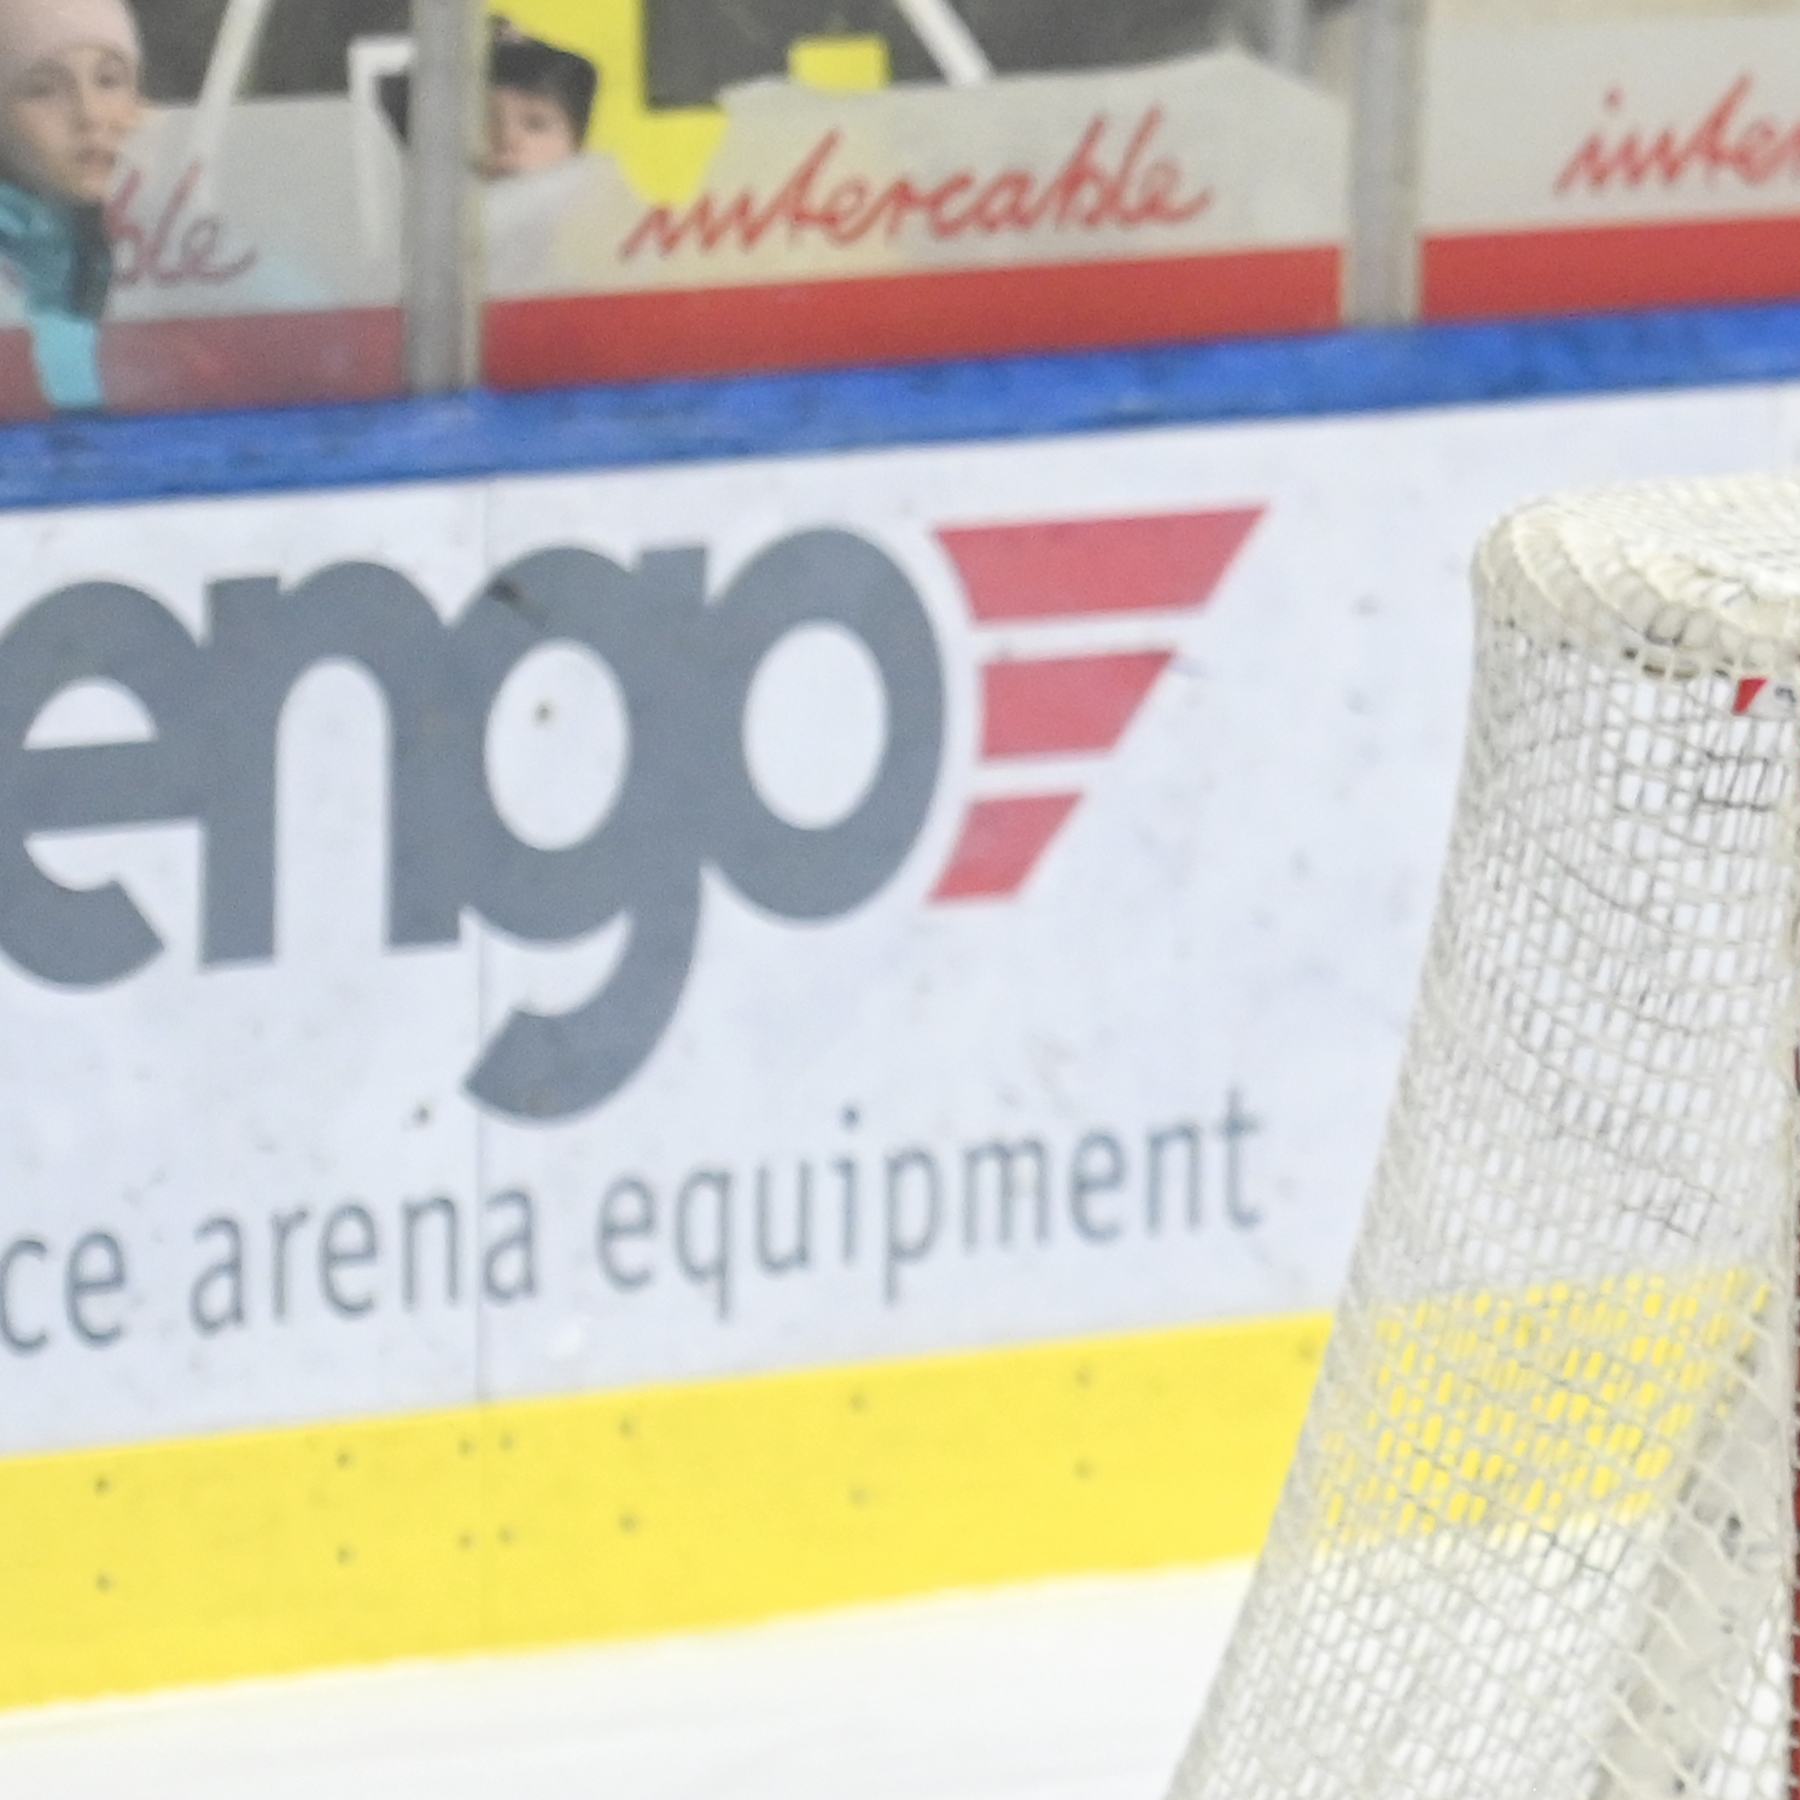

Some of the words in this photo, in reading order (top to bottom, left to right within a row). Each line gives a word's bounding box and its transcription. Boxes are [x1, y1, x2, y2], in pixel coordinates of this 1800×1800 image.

[621, 107, 1214, 262] intercable
[0, 525, 947, 1125] engo
[185, 1178, 540, 1338] arena
[592, 1080, 1266, 1328] equipment
